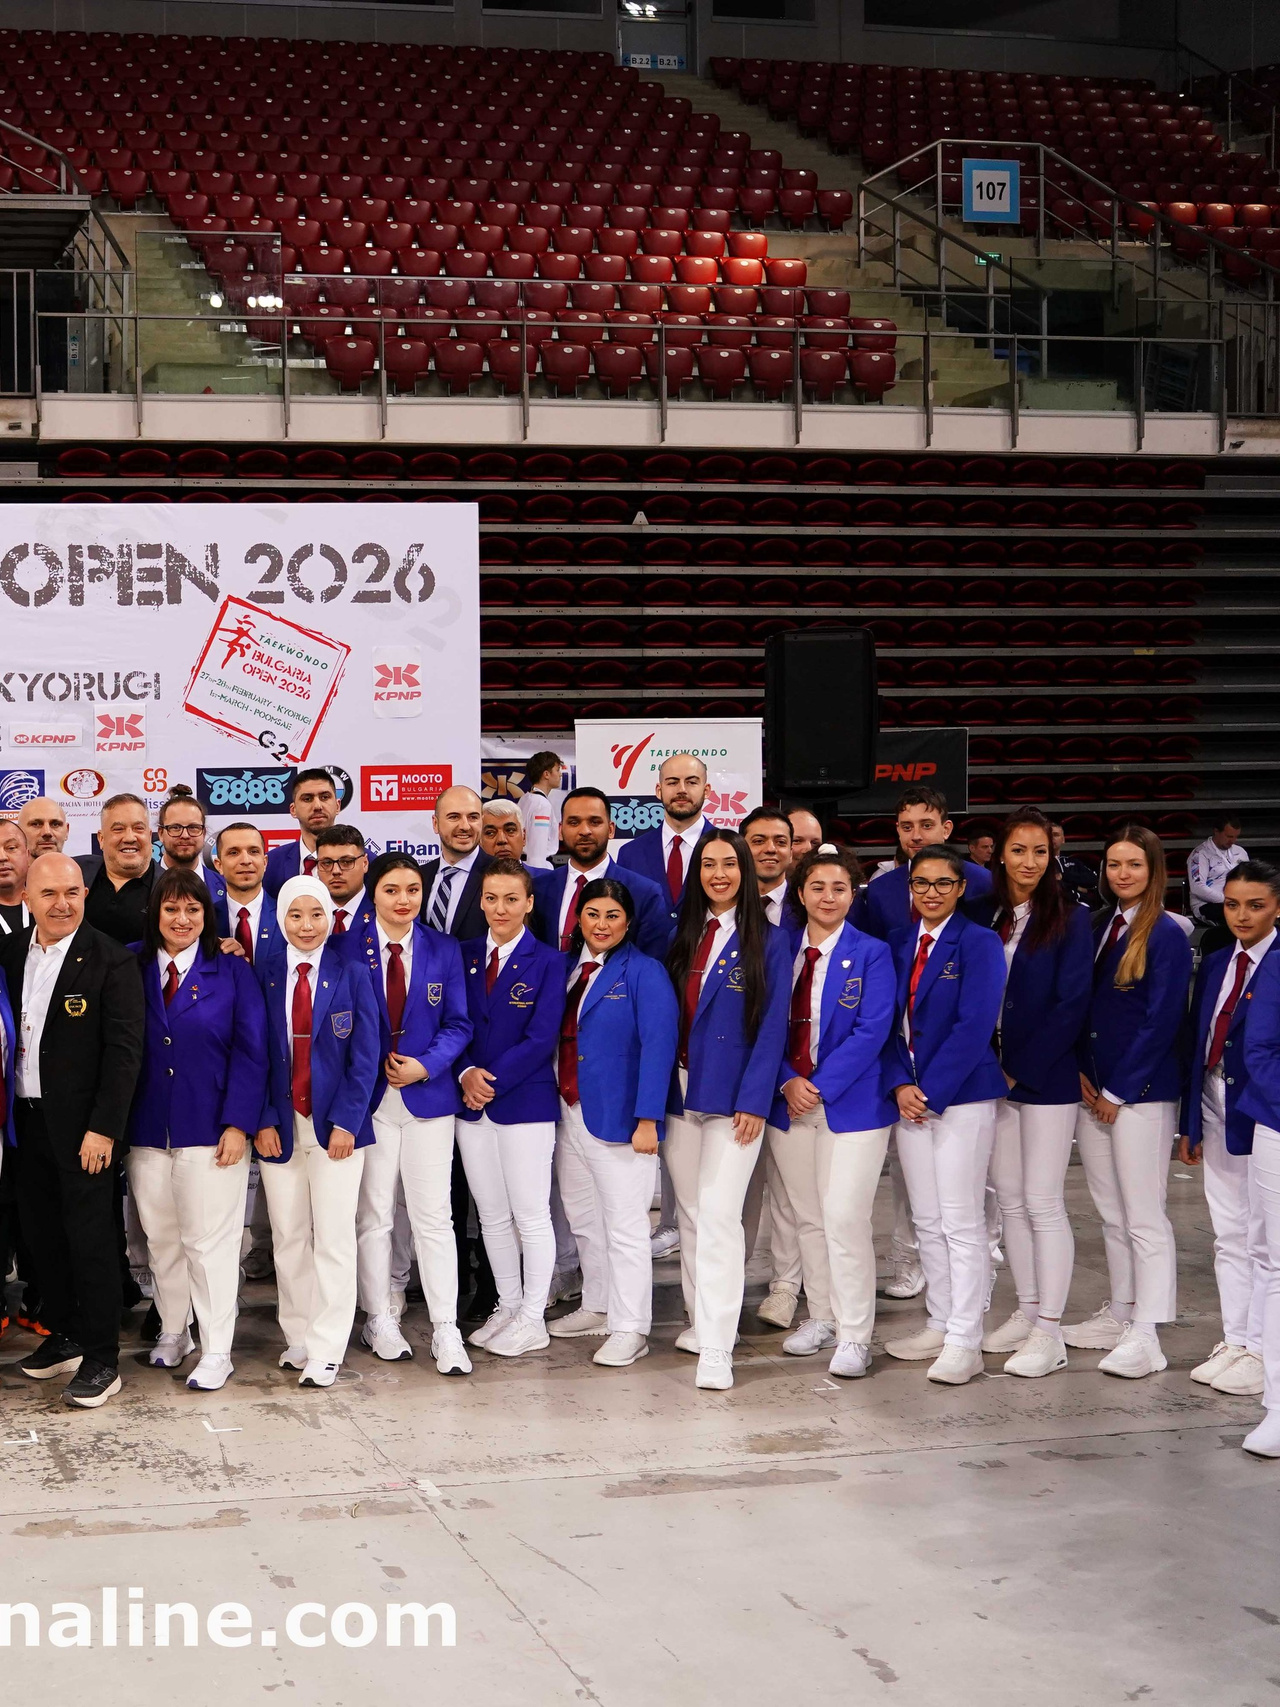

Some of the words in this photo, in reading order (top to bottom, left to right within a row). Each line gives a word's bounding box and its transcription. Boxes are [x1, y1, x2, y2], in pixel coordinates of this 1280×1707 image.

[631, 57, 650, 65] B.2.2
[659, 58, 677, 66] B.2.1
[976, 181, 1007, 200] 107
[0, 542, 221, 607] OPEN
[244, 542, 435, 603] 2026
[258, 634, 329, 670] TAEKWONDO
[251, 649, 313, 686] BULGARIA
[242, 662, 278, 685] OPEN
[278, 678, 311, 701] 2026
[231, 685, 272, 708] FEBRUARY
[276, 704, 312, 725] KYORUGI
[374, 691, 422, 701] KPNP
[253, 708, 293, 731] POOMSAE
[30, 733, 76, 744] KPNP
[96, 742, 146, 751] KPNP
[258, 730, 289, 762] G2
[401, 774, 443, 784] MOOTO
[874, 763, 937, 782] PNP
[209, 778, 285, 805] 8888
[386, 840, 440, 856] Fiban
